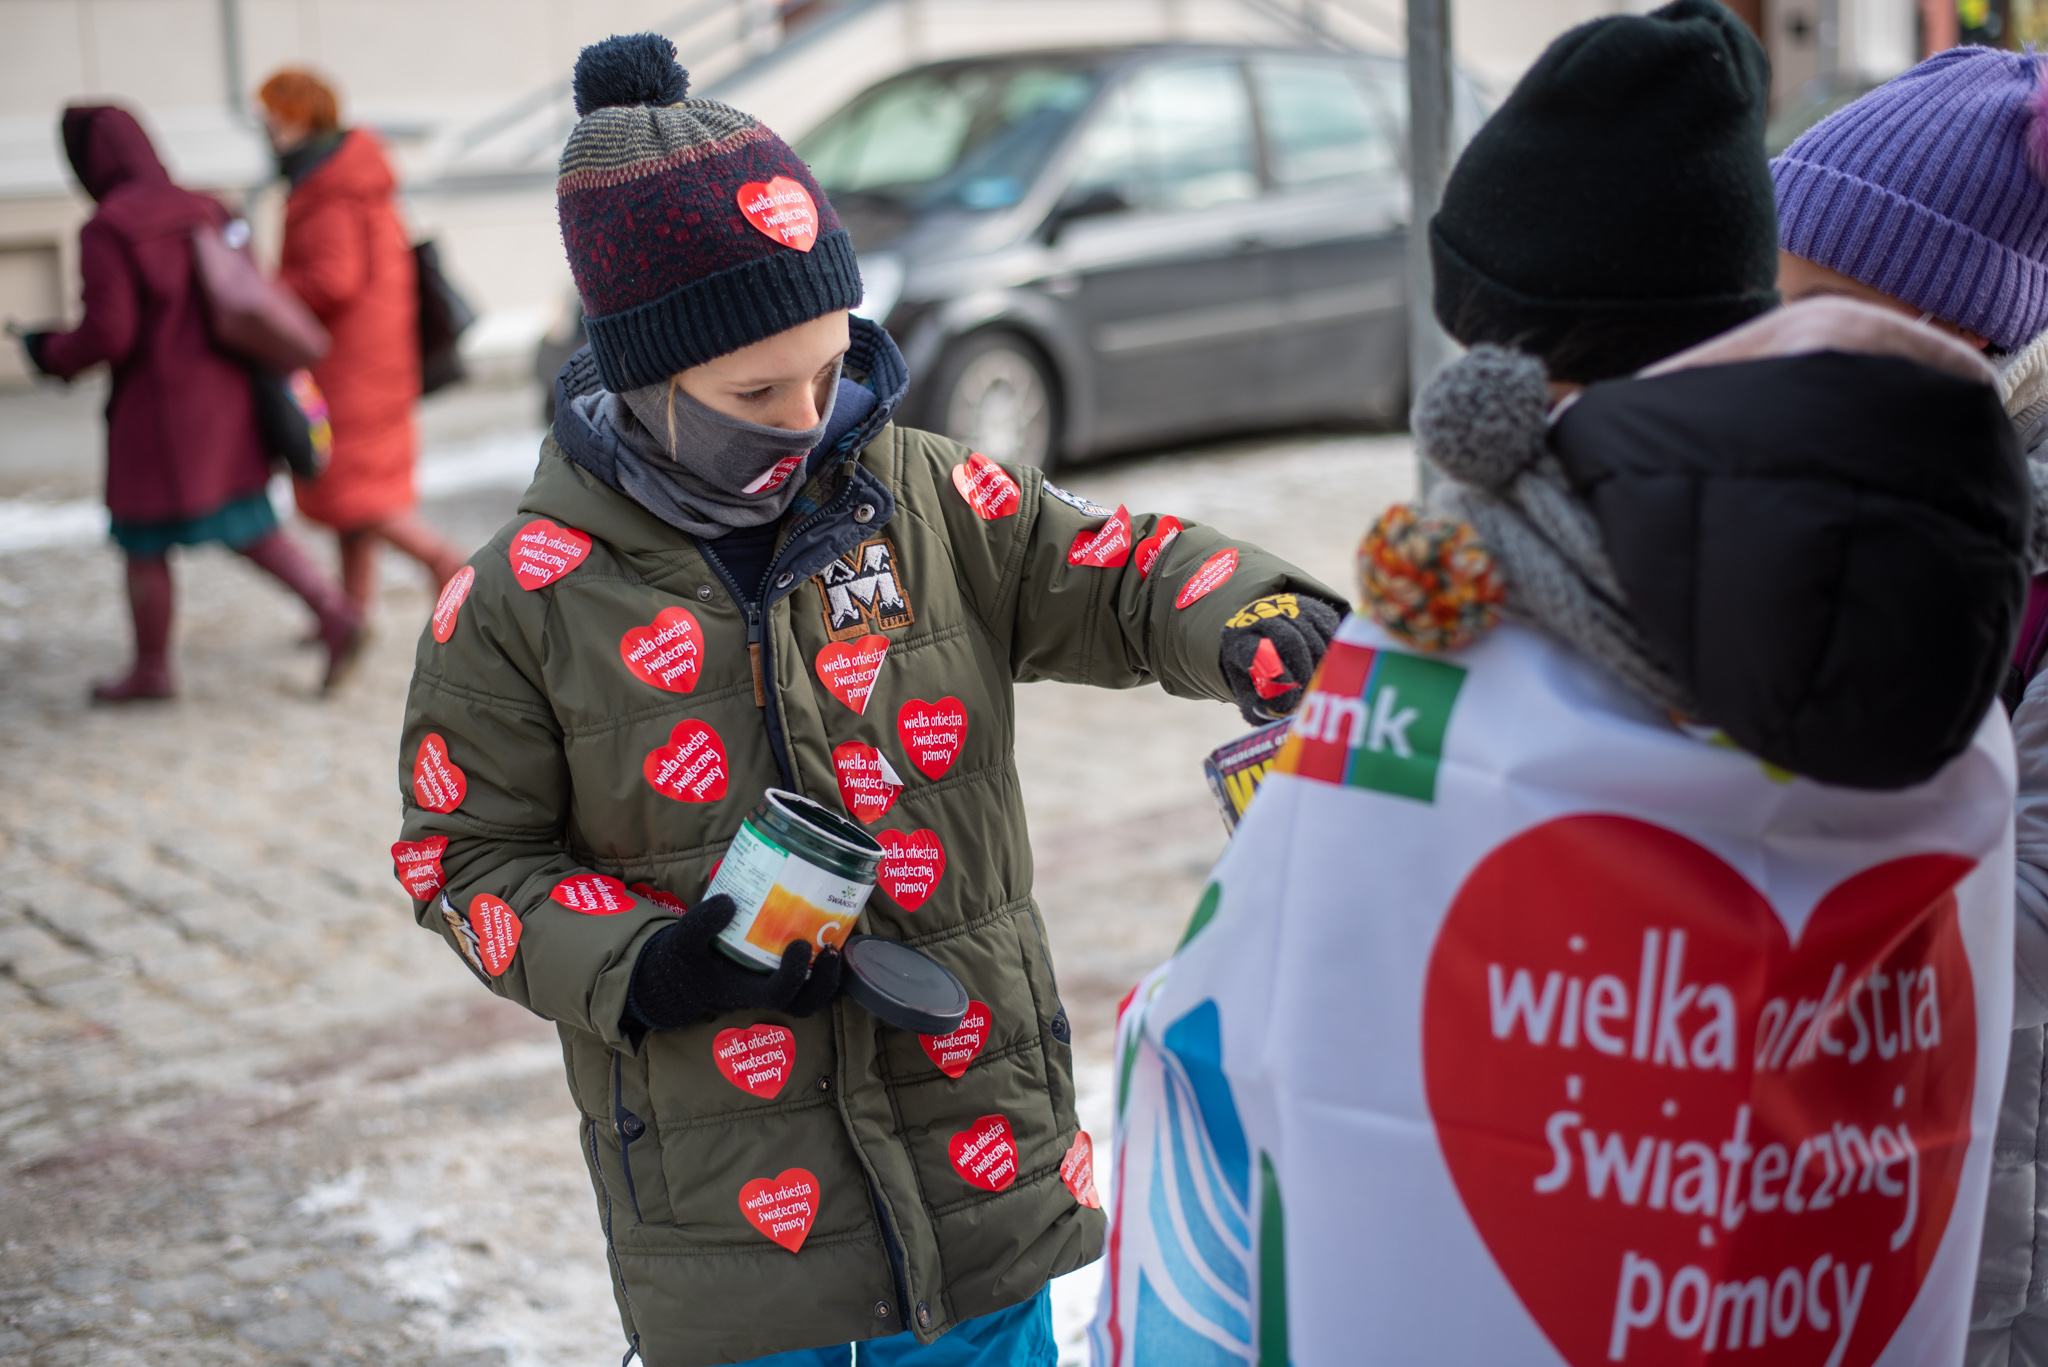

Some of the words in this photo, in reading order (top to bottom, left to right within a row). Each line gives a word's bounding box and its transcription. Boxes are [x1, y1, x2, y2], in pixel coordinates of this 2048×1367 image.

[747, 194, 775, 214] wielka
[774, 189, 806, 205] orkiestra
[762, 205, 813, 228] świątecznej
[780, 223, 813, 243] pomocy
[987, 485, 1016, 516] pomocy
[517, 543, 570, 574] świątecznej
[521, 531, 547, 545] wielka
[546, 537, 582, 558] orkiestra
[1094, 533, 1126, 563] pomocy
[518, 561, 554, 584] pomocy
[628, 638, 657, 662] wielka
[655, 620, 692, 646] orkiestra
[643, 635, 697, 675] świątecznej
[661, 658, 696, 686] pomocy
[822, 654, 851, 673] wielka
[834, 669, 877, 688] świąteczn
[847, 685, 870, 703] pomo
[904, 711, 930, 729] wielka
[931, 710, 962, 726] orkiestra
[912, 729, 958, 750] świątecznej
[426, 741, 442, 768] wielka
[438, 766, 459, 801] orkiestra
[655, 759, 681, 786] wielka
[676, 730, 709, 763] orkiestra
[670, 745, 721, 793] świątecznej
[838, 753, 867, 770] wielka
[922, 749, 952, 766] pomocy
[417, 775, 436, 807] pomocy
[421, 756, 449, 808] świątecznej
[692, 765, 725, 799] pomocy
[854, 793, 888, 811] pomocy
[397, 846, 422, 864] wielka
[884, 842, 905, 860] ielka
[906, 843, 939, 860] orkiestra
[884, 861, 935, 883] świątecznej
[412, 879, 441, 897] pomocy
[895, 882, 928, 898] pomocy
[480, 902, 493, 939] orkiestra
[491, 905, 508, 959] świątecznej
[504, 912, 515, 947] pomocy
[486, 940, 500, 969] wielka
[1488, 927, 1736, 1072] wielka
[718, 1038, 748, 1059] wielka
[748, 1029, 786, 1050] orkiestra
[932, 1029, 980, 1051] świątecznej
[732, 1045, 787, 1075] świątecznej
[942, 1048, 973, 1065] pomocy
[747, 1067, 782, 1089] pomocy
[957, 1142, 979, 1167] wielka
[976, 1123, 1005, 1150] orkiestra
[970, 1137, 1013, 1178] świątecznej
[987, 1157, 1015, 1187] pomocy
[1532, 1074, 1920, 1253] świątecznej
[746, 1190, 775, 1210] wielka
[774, 1181, 812, 1201] orkiestra
[758, 1197, 811, 1223] świątecznej
[772, 1217, 806, 1237] pomocy
[1607, 1250, 1873, 1367] pomocy
